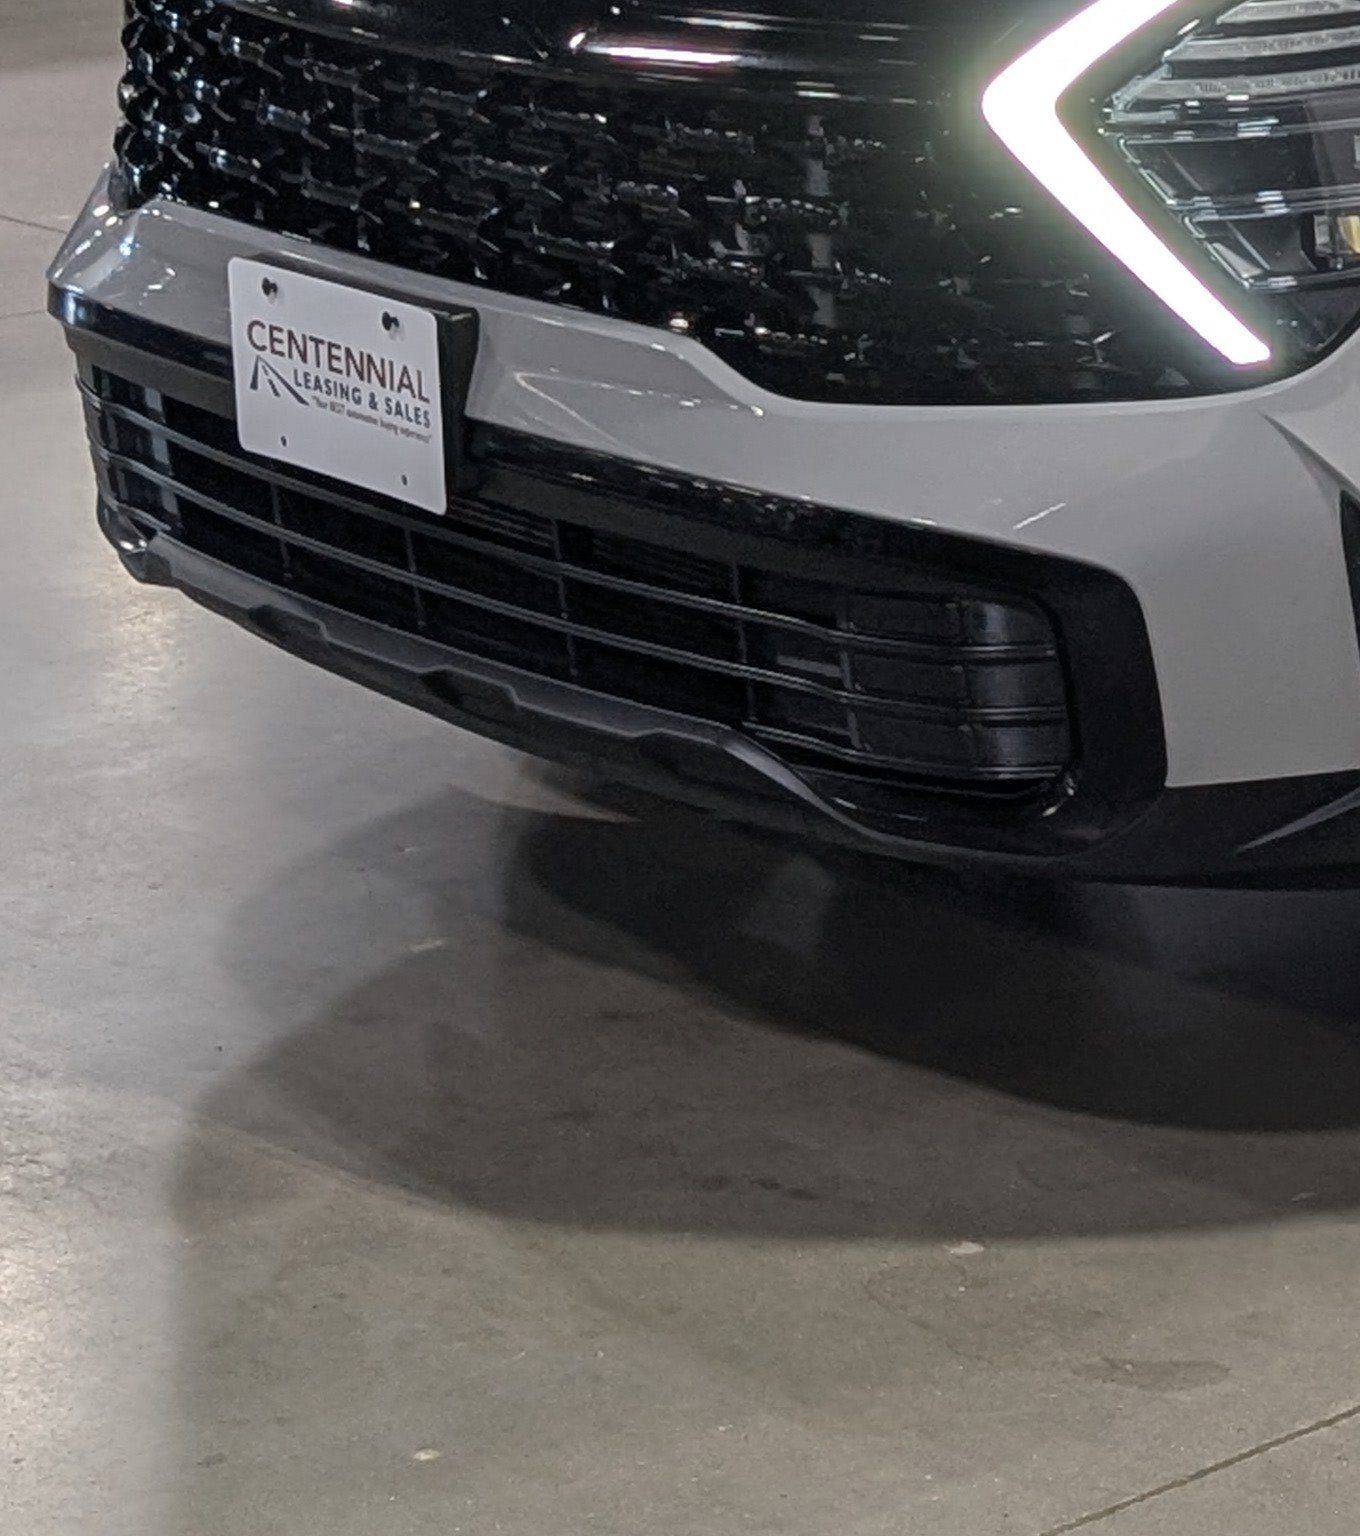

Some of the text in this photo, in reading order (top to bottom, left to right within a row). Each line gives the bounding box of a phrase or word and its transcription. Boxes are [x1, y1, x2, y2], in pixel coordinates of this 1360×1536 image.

[247, 320, 430, 404] CENTENNIAL
[293, 369, 362, 406] LEASING
[368, 392, 379, 412] &
[384, 396, 431, 428] SALES
